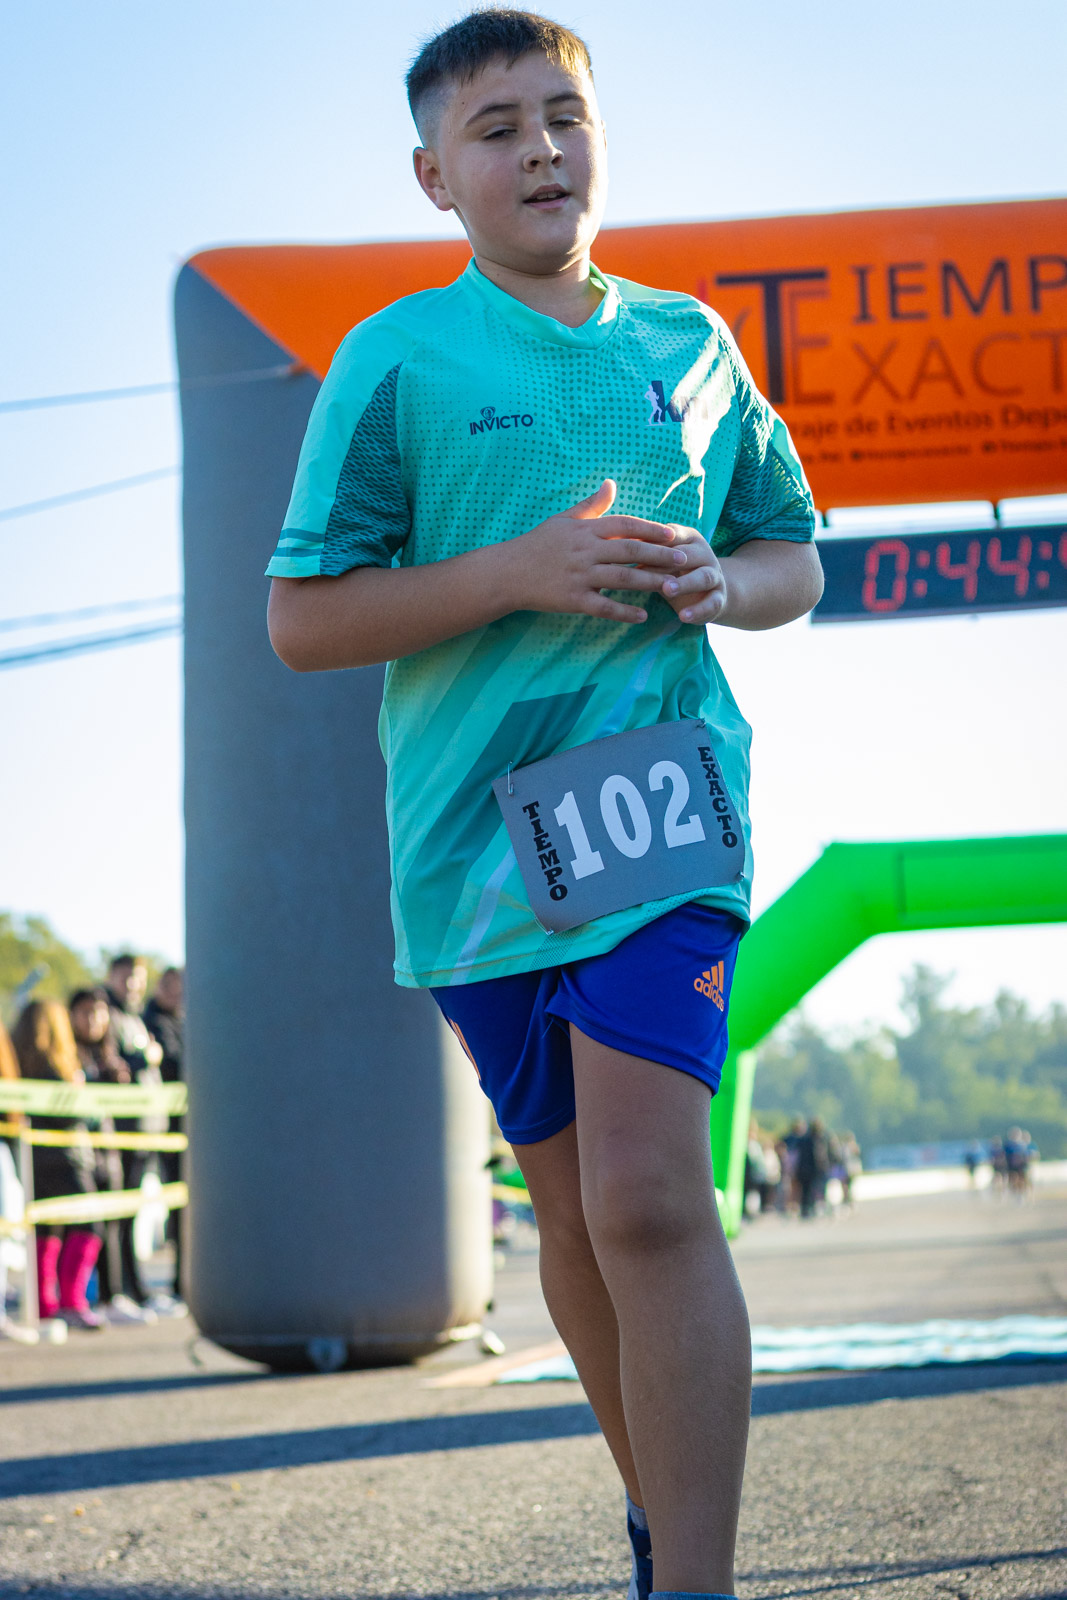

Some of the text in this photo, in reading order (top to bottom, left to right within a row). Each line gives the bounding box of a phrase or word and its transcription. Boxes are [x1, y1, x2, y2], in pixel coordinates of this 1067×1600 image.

[469, 413, 534, 436] INVICTO
[862, 532, 1067, 613] 0:44:
[553, 760, 706, 881] 102
[697, 746, 738, 849] EXACTO
[522, 800, 568, 901] TIEMPO
[693, 977, 725, 1013] adidas
